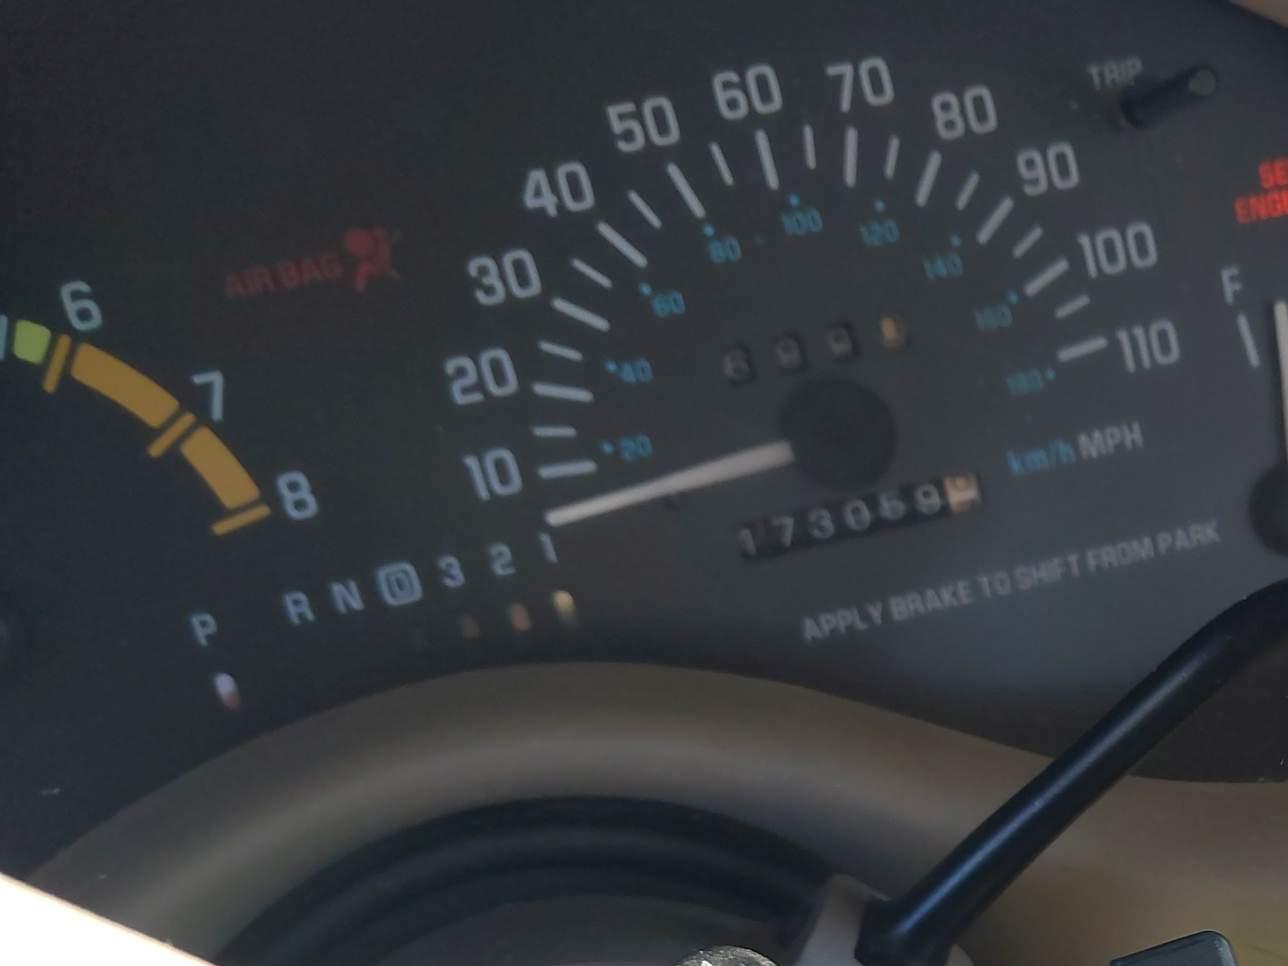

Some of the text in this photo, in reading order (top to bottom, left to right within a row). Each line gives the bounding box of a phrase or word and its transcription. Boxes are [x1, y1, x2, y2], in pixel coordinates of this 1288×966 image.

[713, 63, 783, 121] 60
[826, 57, 894, 112] 70
[1087, 56, 1143, 90] TRIP
[607, 96, 680, 153] 50
[931, 85, 998, 140] 80
[524, 161, 595, 218] 40
[1016, 141, 1080, 196] 90
[782, 207, 823, 236] 100
[225, 252, 343, 298] AIR BAG
[467, 249, 542, 306] 30
[1077, 221, 1158, 279] 100
[60, 280, 103, 332] 6
[1221, 266, 1243, 305] F
[1116, 318, 1181, 374] 110
[192, 370, 225, 421] 7
[444, 347, 519, 405] 20
[1077, 420, 1144, 460] MPH
[275, 470, 319, 520] 8
[462, 447, 523, 502] 10
[190, 613, 218, 647] P
[283, 591, 316, 626] R
[330, 579, 365, 614] N
[437, 554, 466, 589] 3
[488, 542, 516, 576] 2
[803, 519, 1222, 643] APPLY BRAKE TO SHIFT FROM PARK
